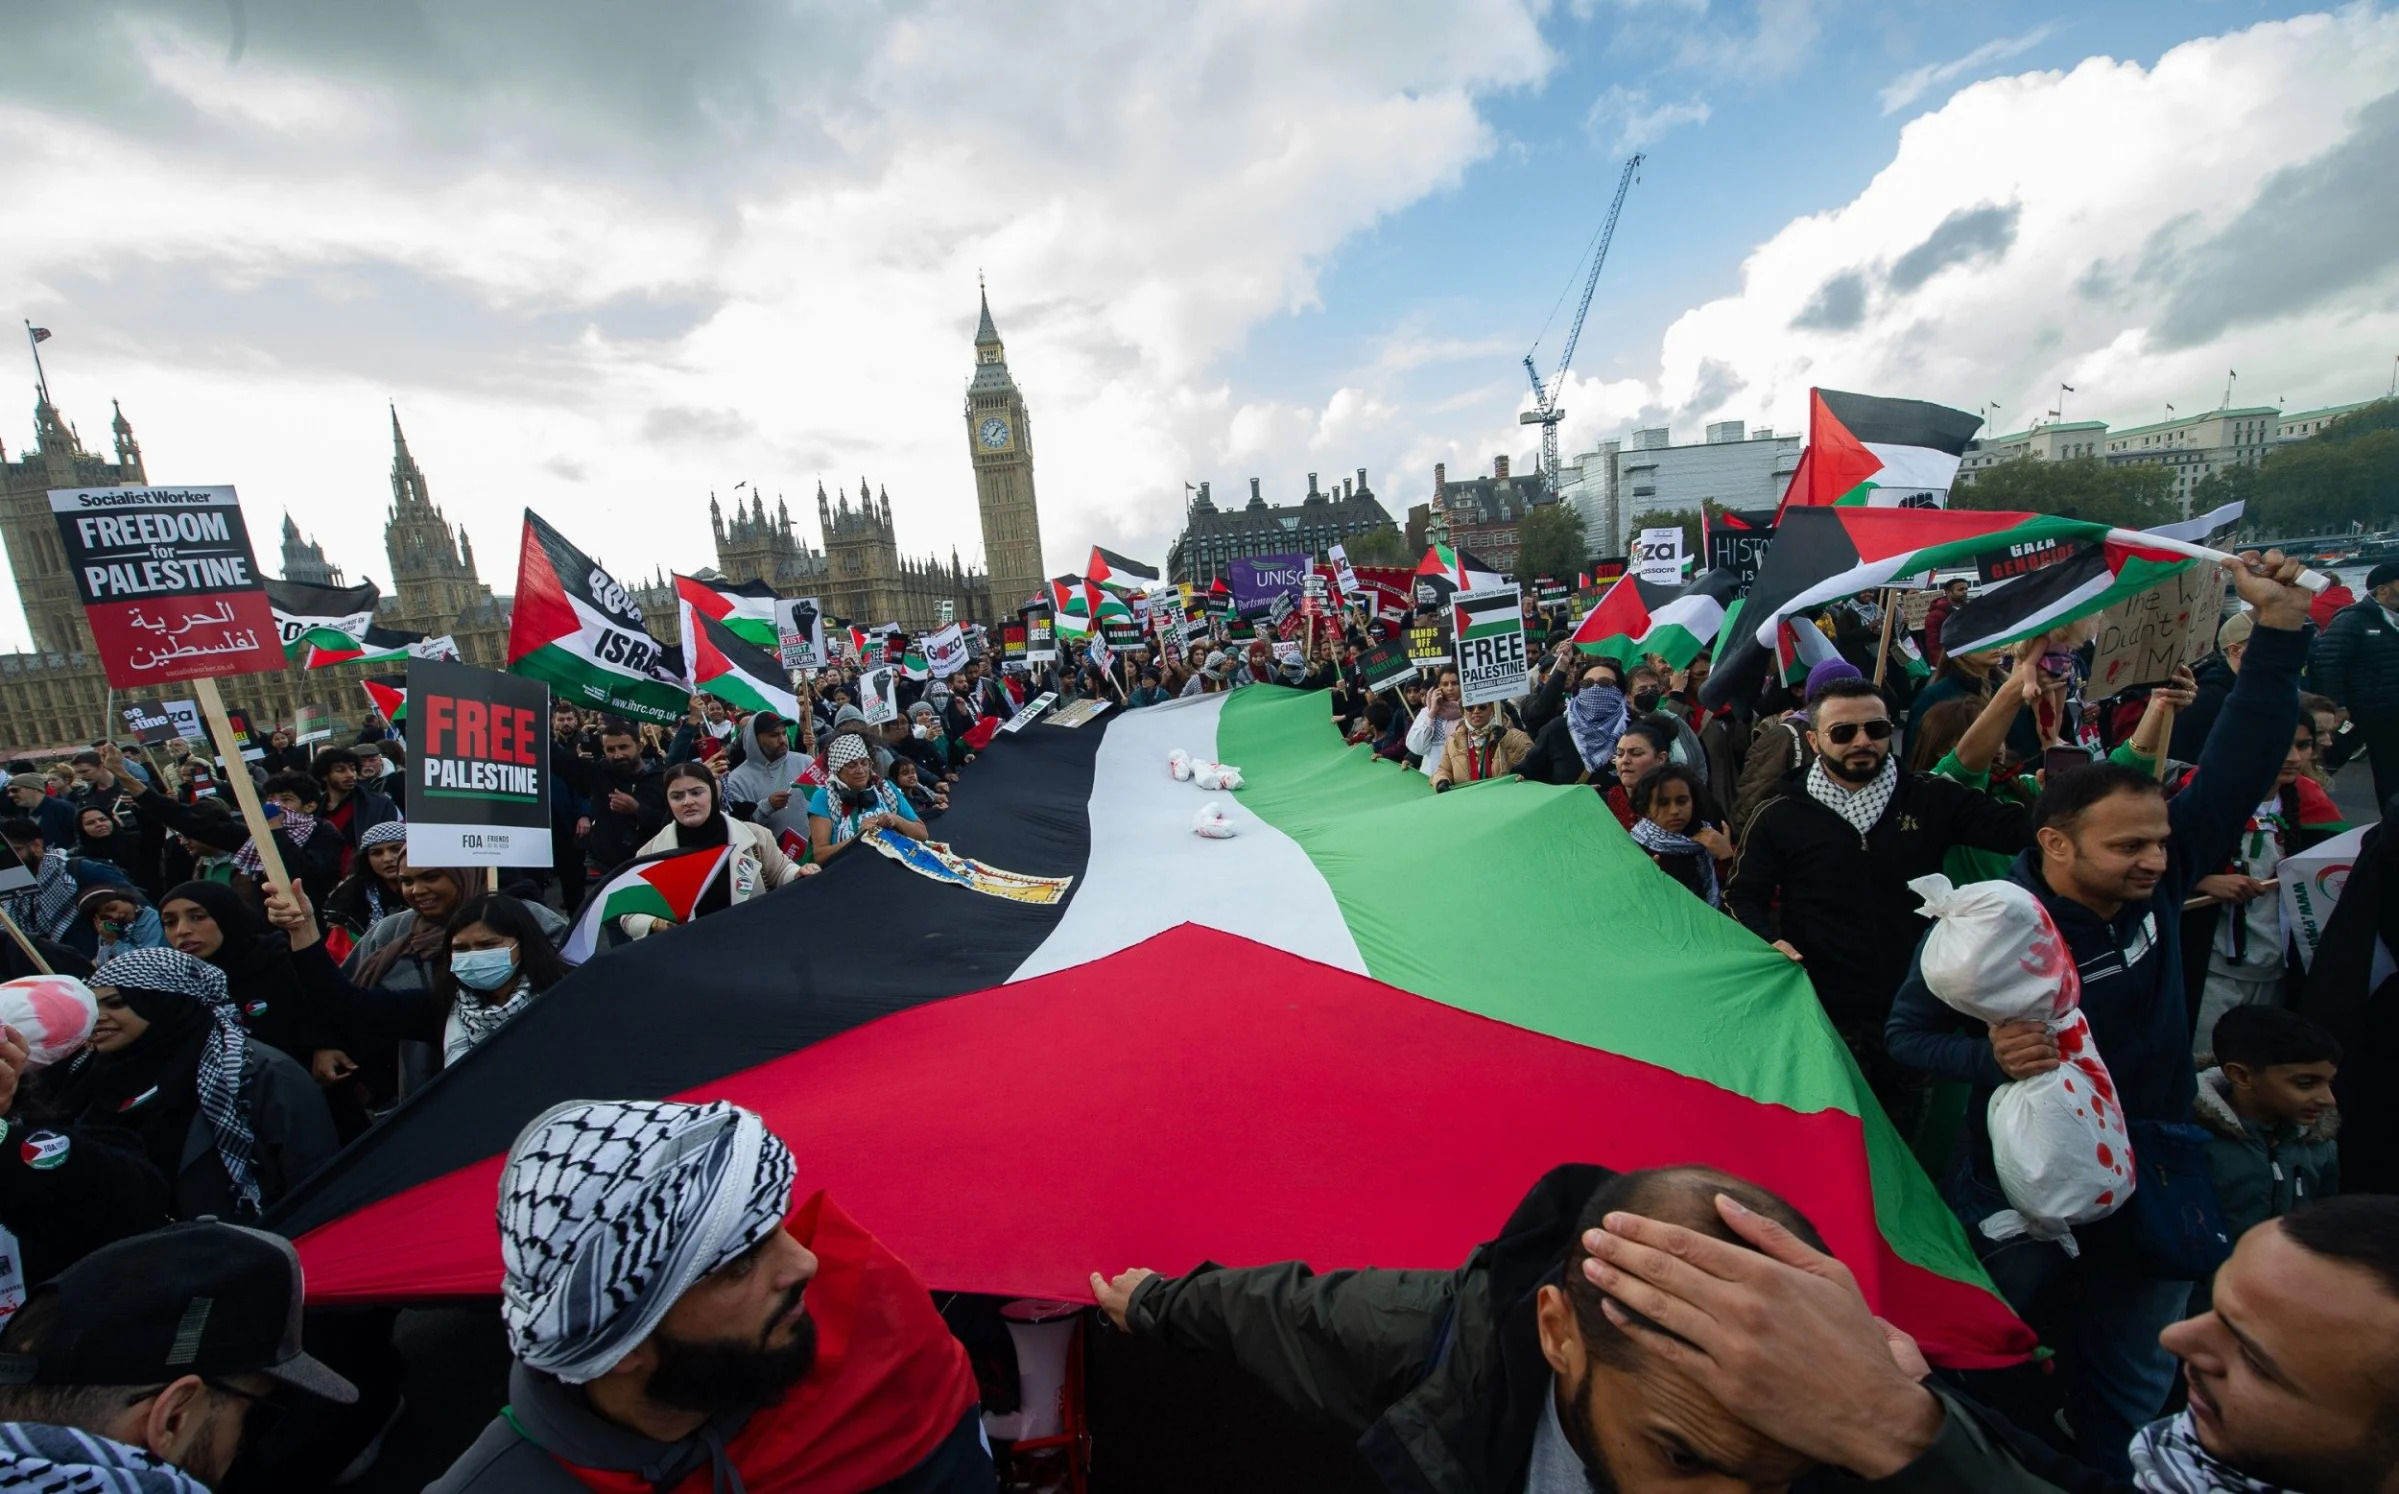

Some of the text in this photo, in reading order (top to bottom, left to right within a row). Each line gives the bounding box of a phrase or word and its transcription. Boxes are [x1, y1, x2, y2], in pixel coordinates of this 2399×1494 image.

[76, 512, 230, 549] FREEDOM
[150, 544, 175, 559] for
[1642, 543, 1676, 561] za
[2010, 538, 2056, 558] GAZA
[1596, 563, 1623, 577] STOP
[1990, 543, 2075, 580] GENOCIDE
[84, 557, 252, 597] PALESTINE
[1742, 570, 1755, 581] IS
[128, 601, 235, 635] الحرية
[1030, 628, 1051, 640] SIEGE
[1109, 629, 1140, 638] BOMBING
[1410, 627, 1438, 639] HANDS
[2101, 612, 2174, 656] Didn't
[130, 628, 260, 669] لفلسطين
[1416, 638, 1431, 648] OFF
[1459, 632, 1524, 670] FREE
[783, 653, 817, 667] RETURN.
[1408, 647, 1442, 658] AL-AQSA
[1462, 660, 1526, 683] PALESTINE
[1464, 674, 1526, 692] END ISRAELI OCCUPATION
[425, 694, 537, 765] FREE
[424, 757, 538, 795] PALESTINE
[462, 834, 483, 849] FOA
[44, 1143, 58, 1152] FOA
